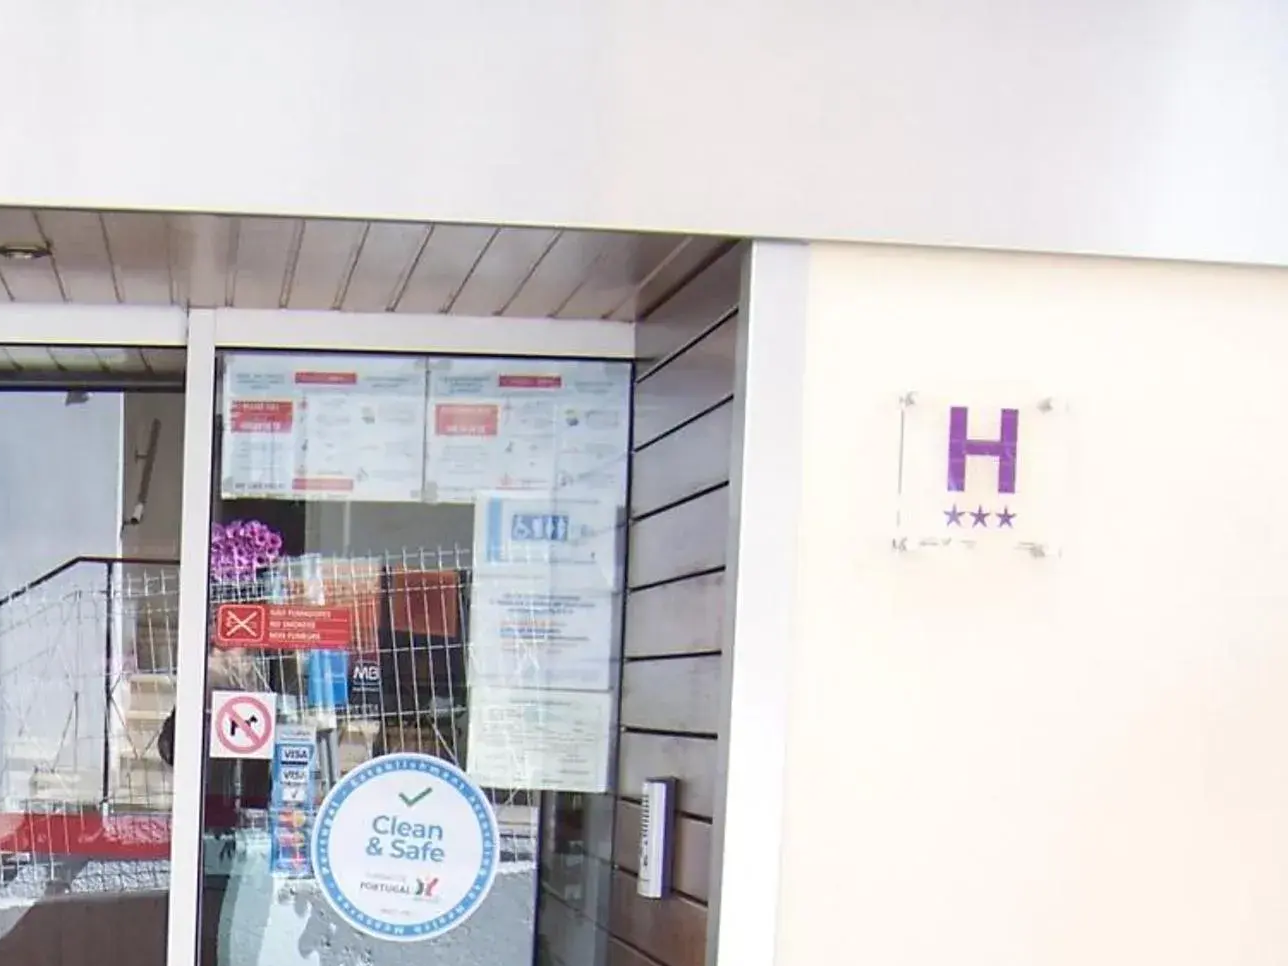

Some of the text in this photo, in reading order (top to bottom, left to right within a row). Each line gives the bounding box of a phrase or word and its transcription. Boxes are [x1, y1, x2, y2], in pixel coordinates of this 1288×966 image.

[947, 406, 1019, 494] H
[353, 665, 380, 680] MB
[284, 749, 308, 759] VISA
[372, 815, 444, 841] Clean
[365, 836, 445, 863] & Safe
[360, 882, 410, 895] PORTUGAL
